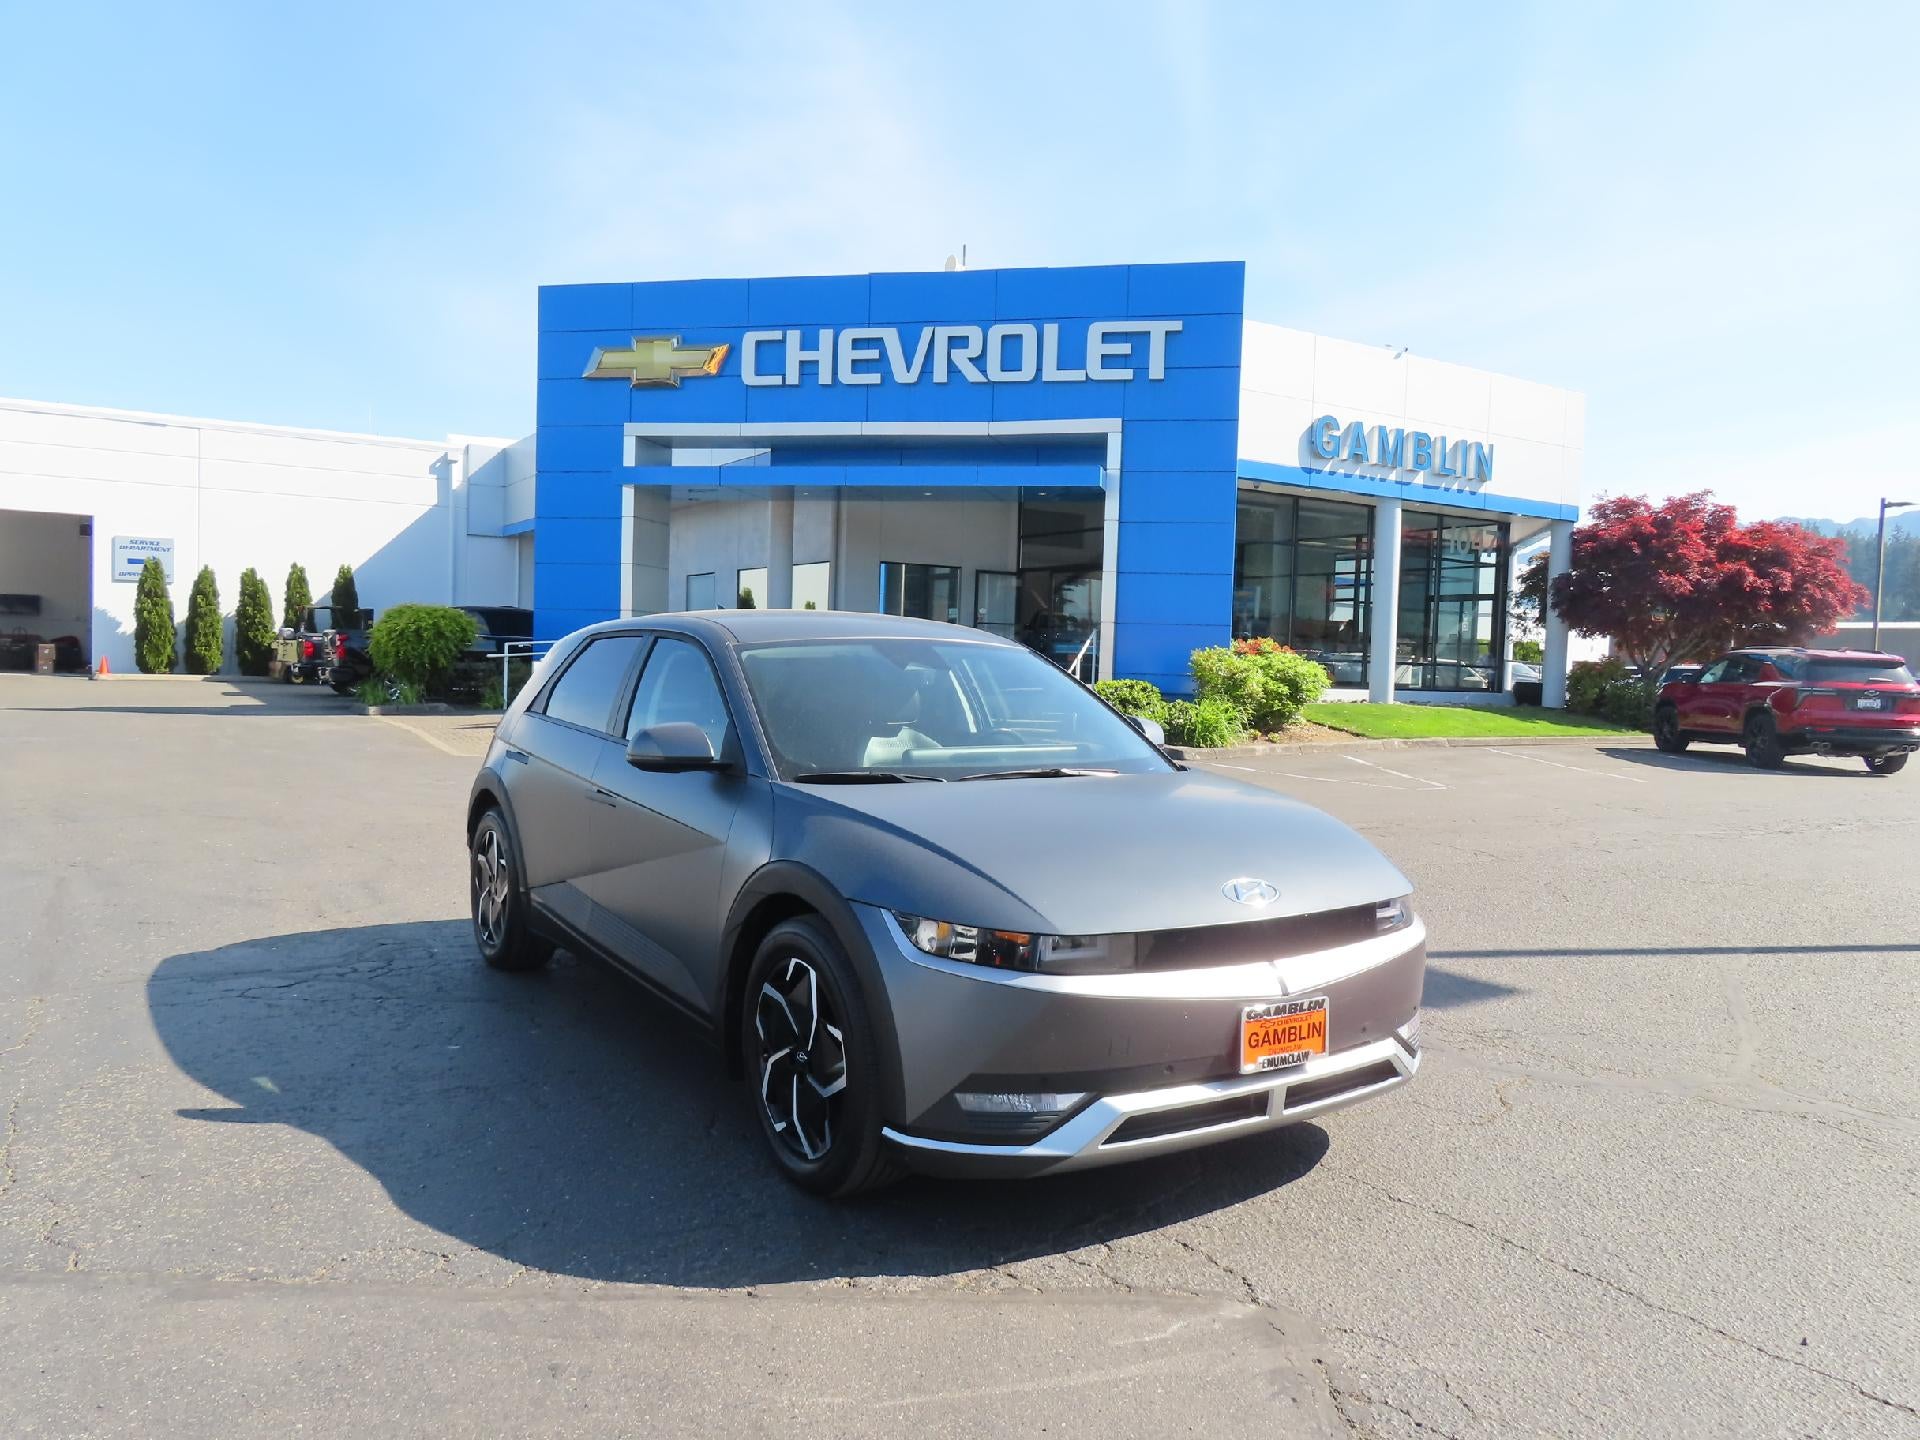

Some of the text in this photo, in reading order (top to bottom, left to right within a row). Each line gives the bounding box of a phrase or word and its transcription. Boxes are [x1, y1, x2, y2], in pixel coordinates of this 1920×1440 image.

[741, 321, 1183, 386] CHEVROLET
[1312, 415, 1494, 482] GAMBLIN
[119, 545, 171, 553] DEPARTMENT
[129, 539, 161, 547] SERVICE
[1246, 999, 1325, 1020] GAMBLIN
[1277, 1014, 1312, 1026] CHEVROLET
[1248, 1021, 1322, 1049] GAMBLIN
[1262, 1051, 1310, 1069] ENUMCLAW
